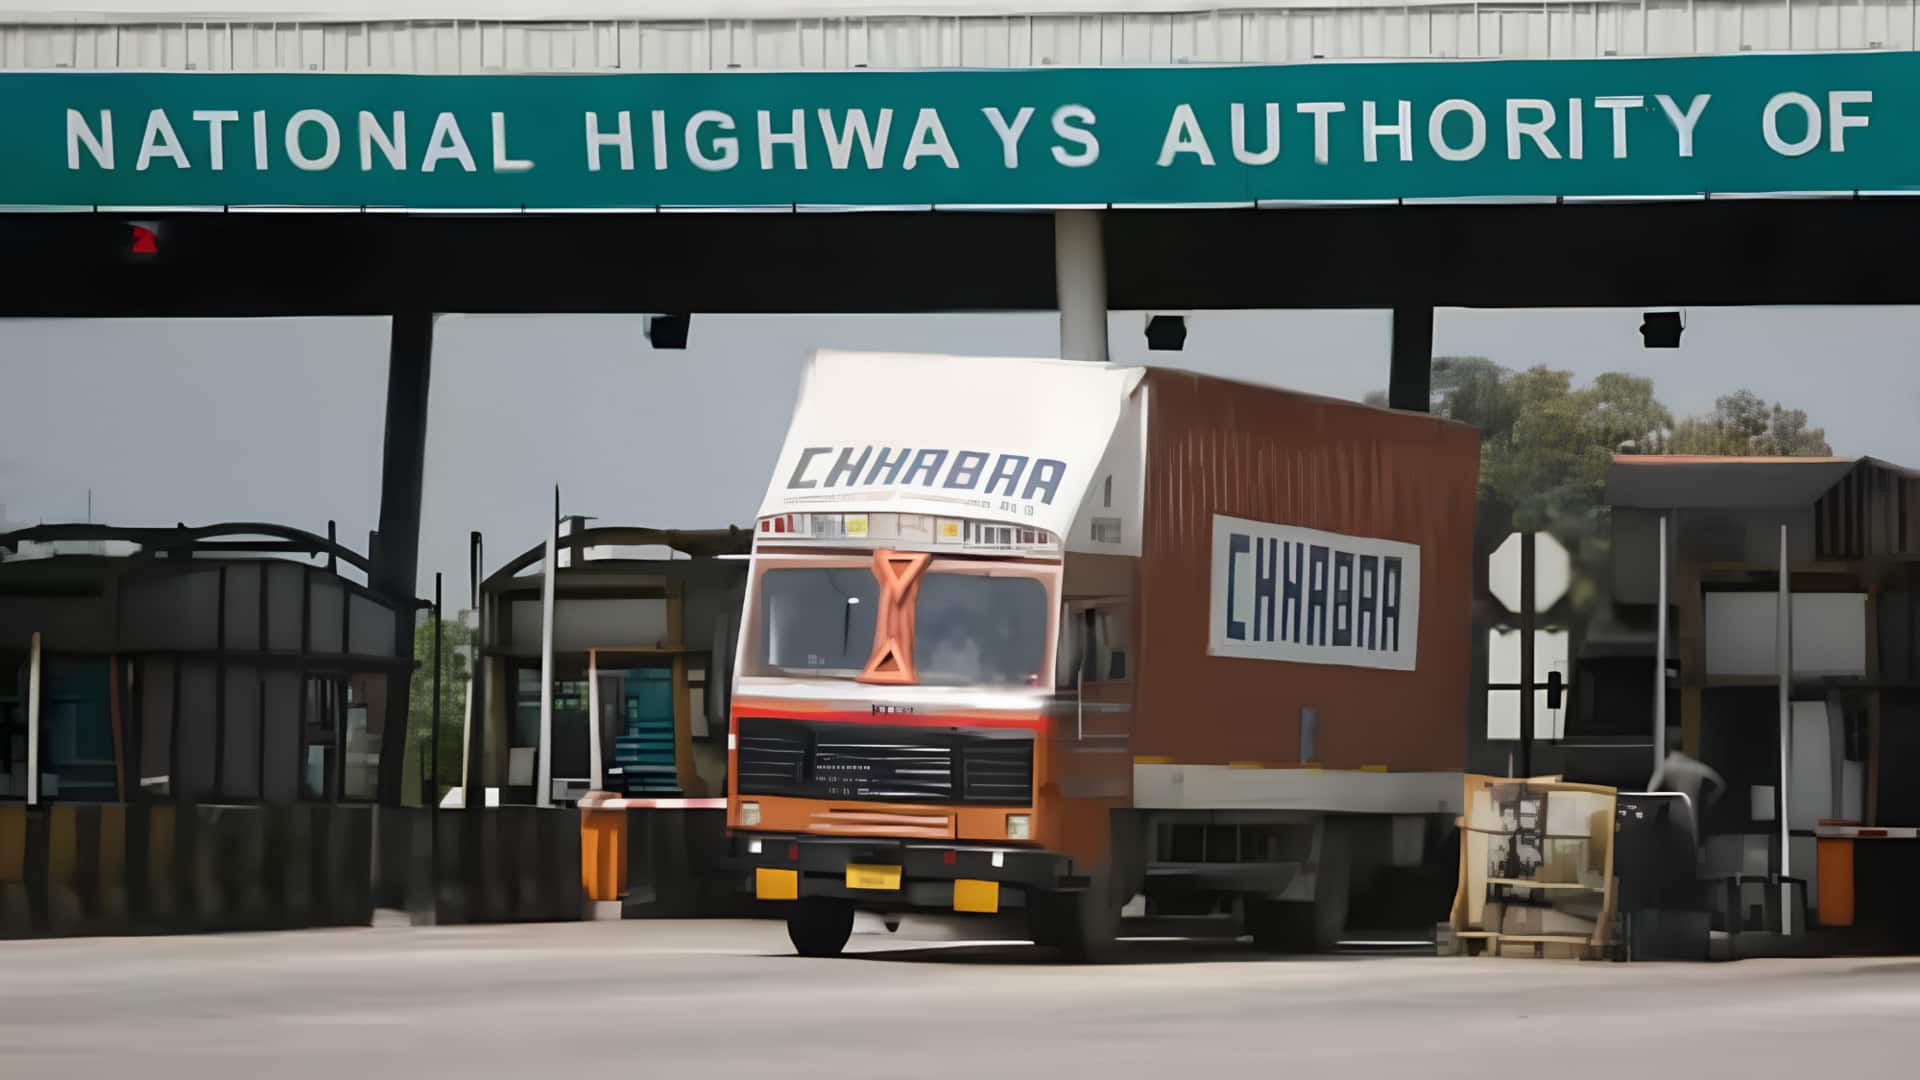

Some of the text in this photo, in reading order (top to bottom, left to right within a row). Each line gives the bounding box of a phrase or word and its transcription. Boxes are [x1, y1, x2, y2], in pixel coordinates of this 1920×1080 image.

[66, 108, 535, 172] NATIONAL
[1156, 94, 1712, 168] AUTHORITY
[1762, 90, 1873, 156] OF
